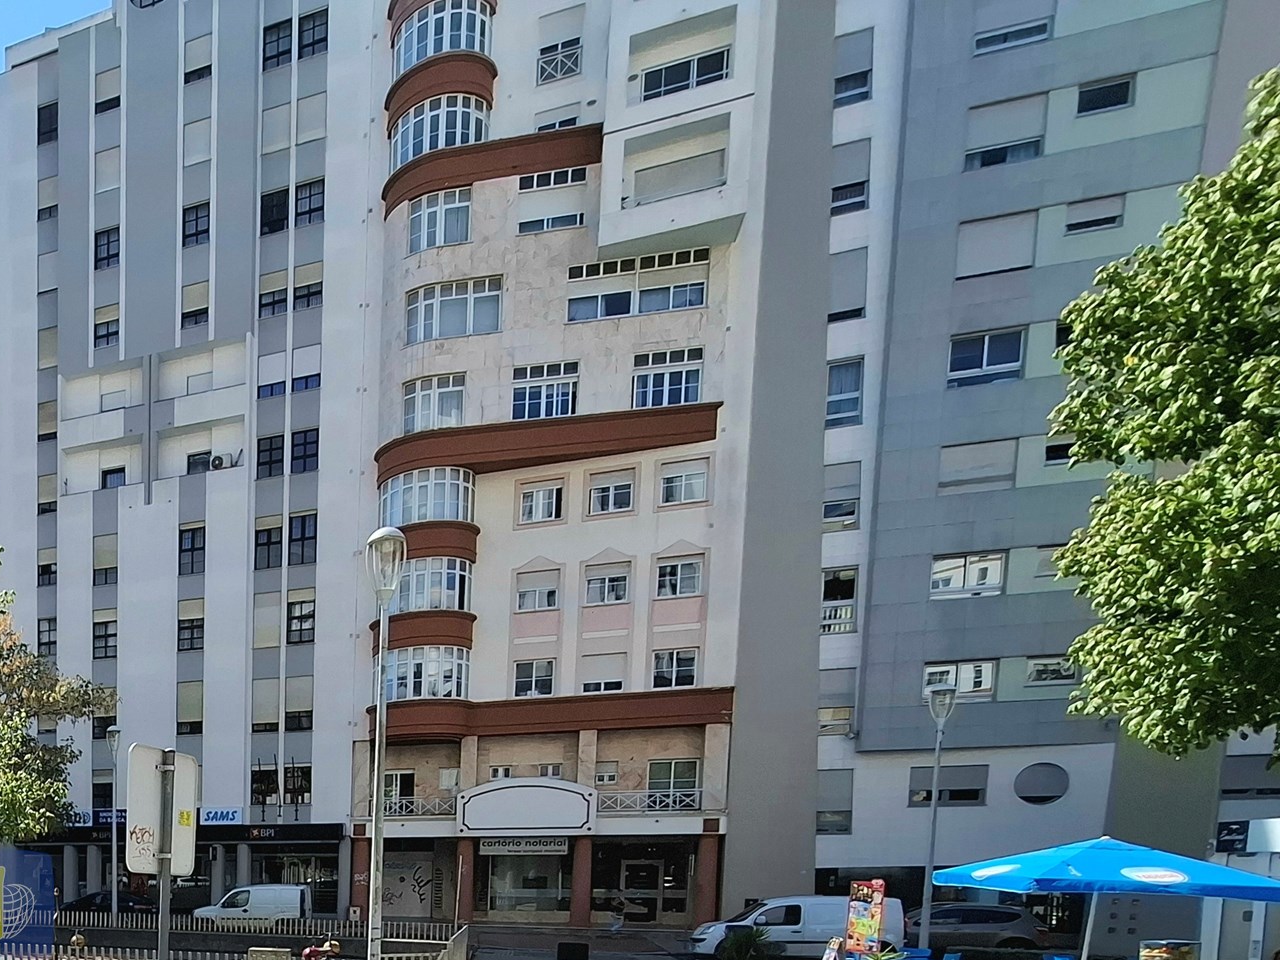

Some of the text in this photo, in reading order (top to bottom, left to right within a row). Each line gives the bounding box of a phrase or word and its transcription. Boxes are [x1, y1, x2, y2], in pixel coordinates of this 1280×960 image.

[204, 810, 238, 822] SAMS
[260, 828, 275, 837] BPI
[524, 838, 567, 847] notarial
